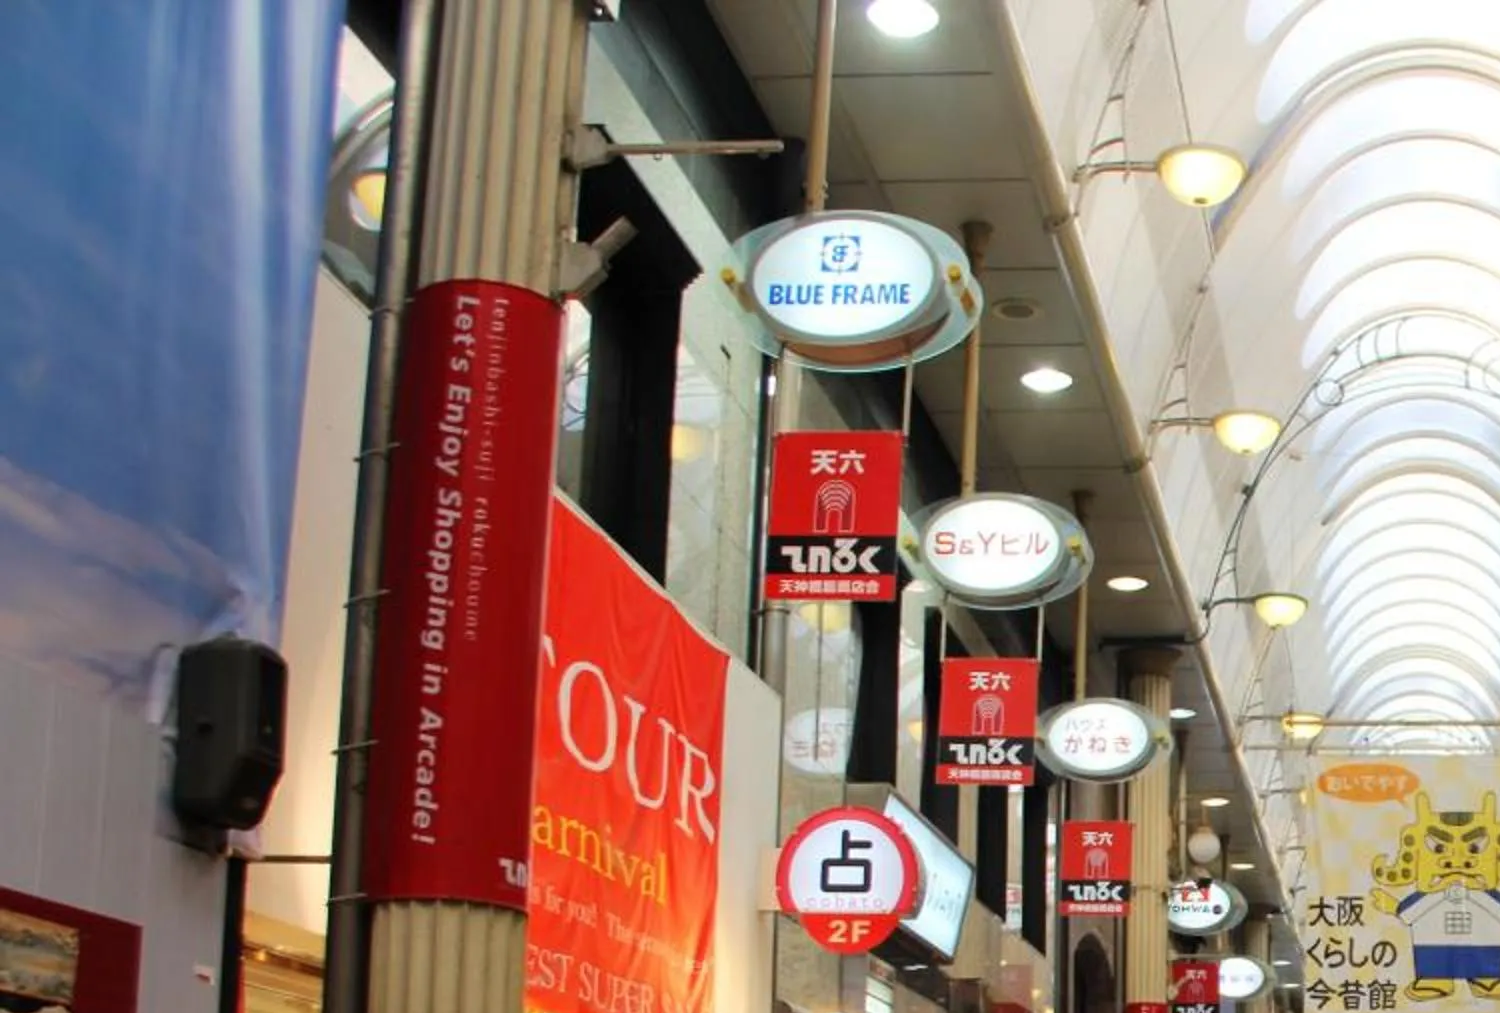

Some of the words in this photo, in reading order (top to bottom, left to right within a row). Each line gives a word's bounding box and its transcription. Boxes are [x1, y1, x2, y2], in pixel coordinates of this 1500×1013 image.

[769, 284, 825, 305] BLUE
[832, 283, 912, 305] FRAME
[451, 295, 481, 373] Let's
[435, 383, 472, 478] Enjoy
[811, 449, 866, 475] 天六
[421, 488, 464, 651] Shopping
[421, 662, 448, 696] in
[968, 671, 1011, 691] 天六
[541, 634, 717, 845] OUR
[1063, 736, 1132, 754] かねき
[411, 707, 444, 845] Arcade!
[1326, 774, 1411, 793] おいでやす
[1082, 831, 1113, 847] 天六
[820, 829, 872, 893] 占
[1308, 895, 1364, 928] 大阪
[828, 920, 871, 943] 2F
[1306, 936, 1398, 969] くらしの
[1306, 977, 1398, 1011] 今昔館
